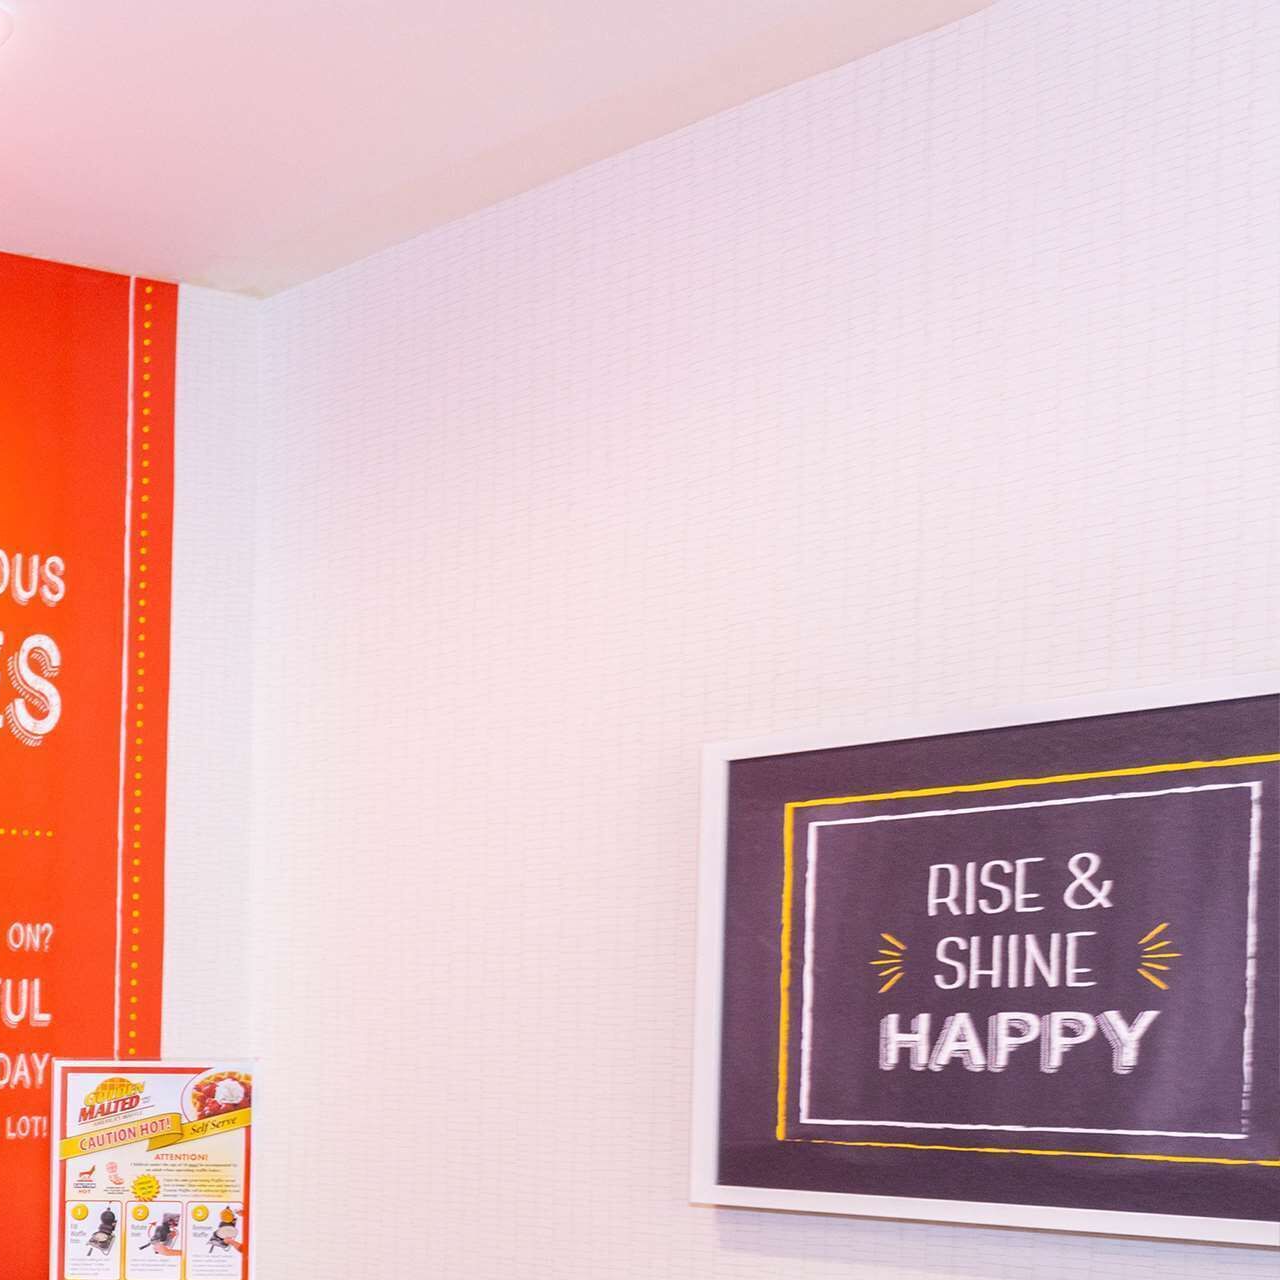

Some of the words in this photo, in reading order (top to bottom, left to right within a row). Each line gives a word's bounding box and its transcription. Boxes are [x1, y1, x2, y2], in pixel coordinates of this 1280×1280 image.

[927, 856, 1046, 917] RISE
[1063, 851, 1114, 911] &
[7, 922, 55, 953] ON?
[933, 931, 1099, 990] SHINE
[879, 1009, 1162, 1075] HAPPY
[79, 1095, 140, 1123] MALTED
[5, 1114, 49, 1139] LOT!
[80, 1128, 137, 1151] CAUTION
[140, 1117, 172, 1136] HOT!
[190, 1123, 209, 1135] Self
[209, 1116, 238, 1131] Serve
